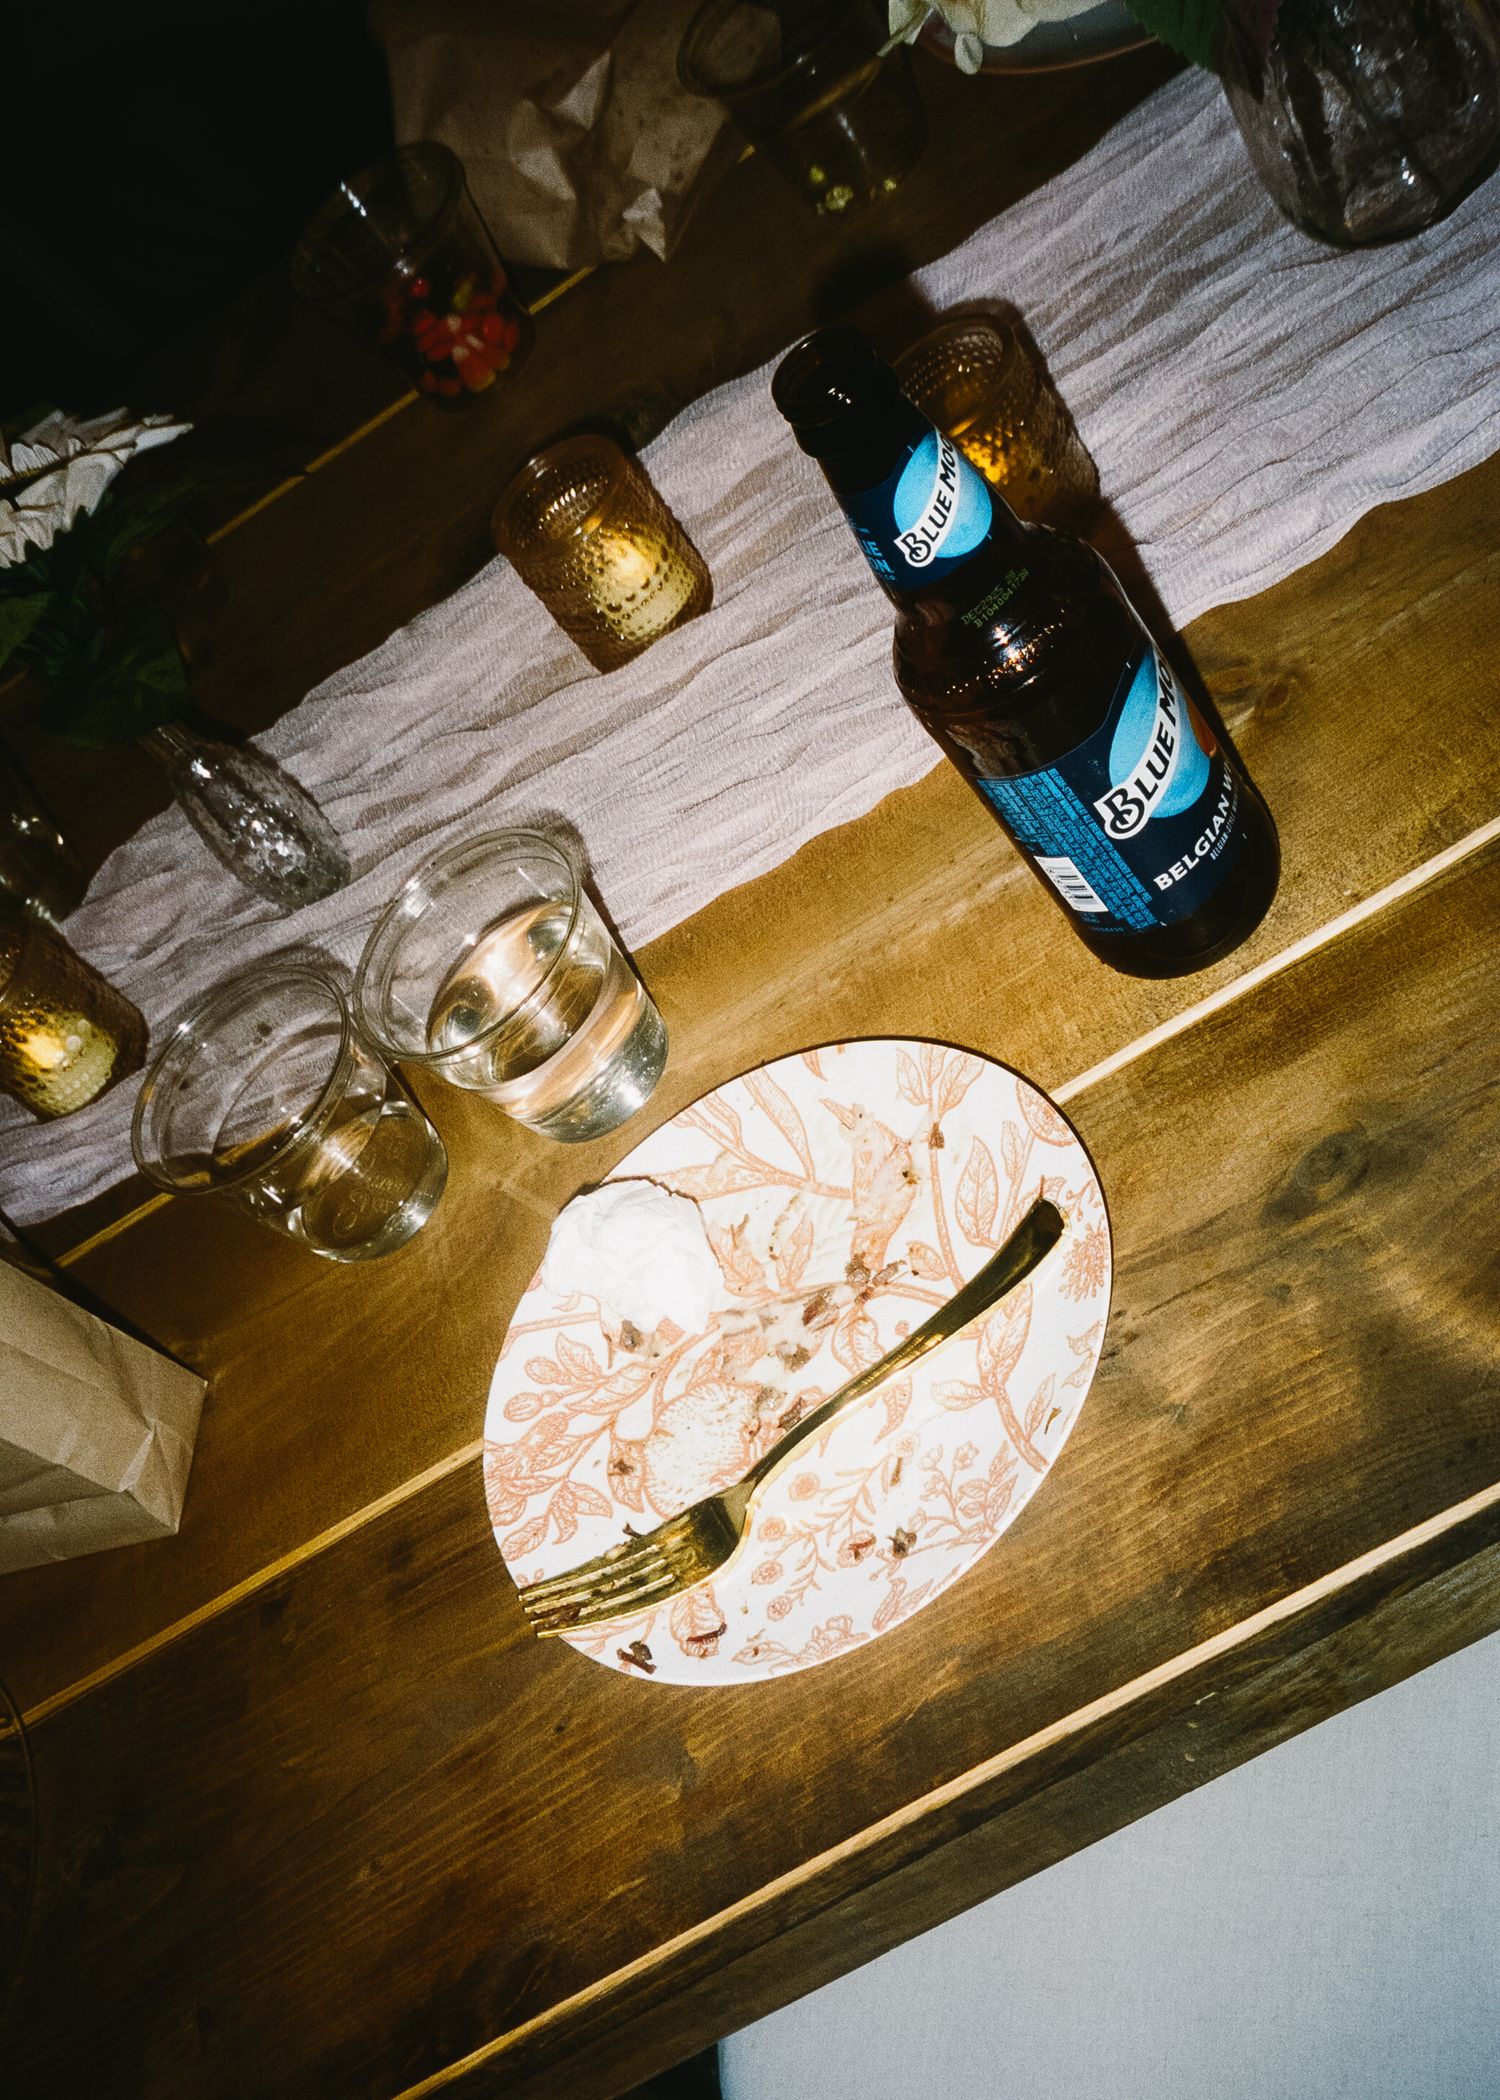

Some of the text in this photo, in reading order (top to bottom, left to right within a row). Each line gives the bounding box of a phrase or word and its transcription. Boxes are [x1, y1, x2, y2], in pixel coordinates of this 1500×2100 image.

[901, 434, 956, 563] BLUE MOO
[1100, 657, 1178, 834] BLUE MO
[1153, 800, 1231, 891] BELGIAN
